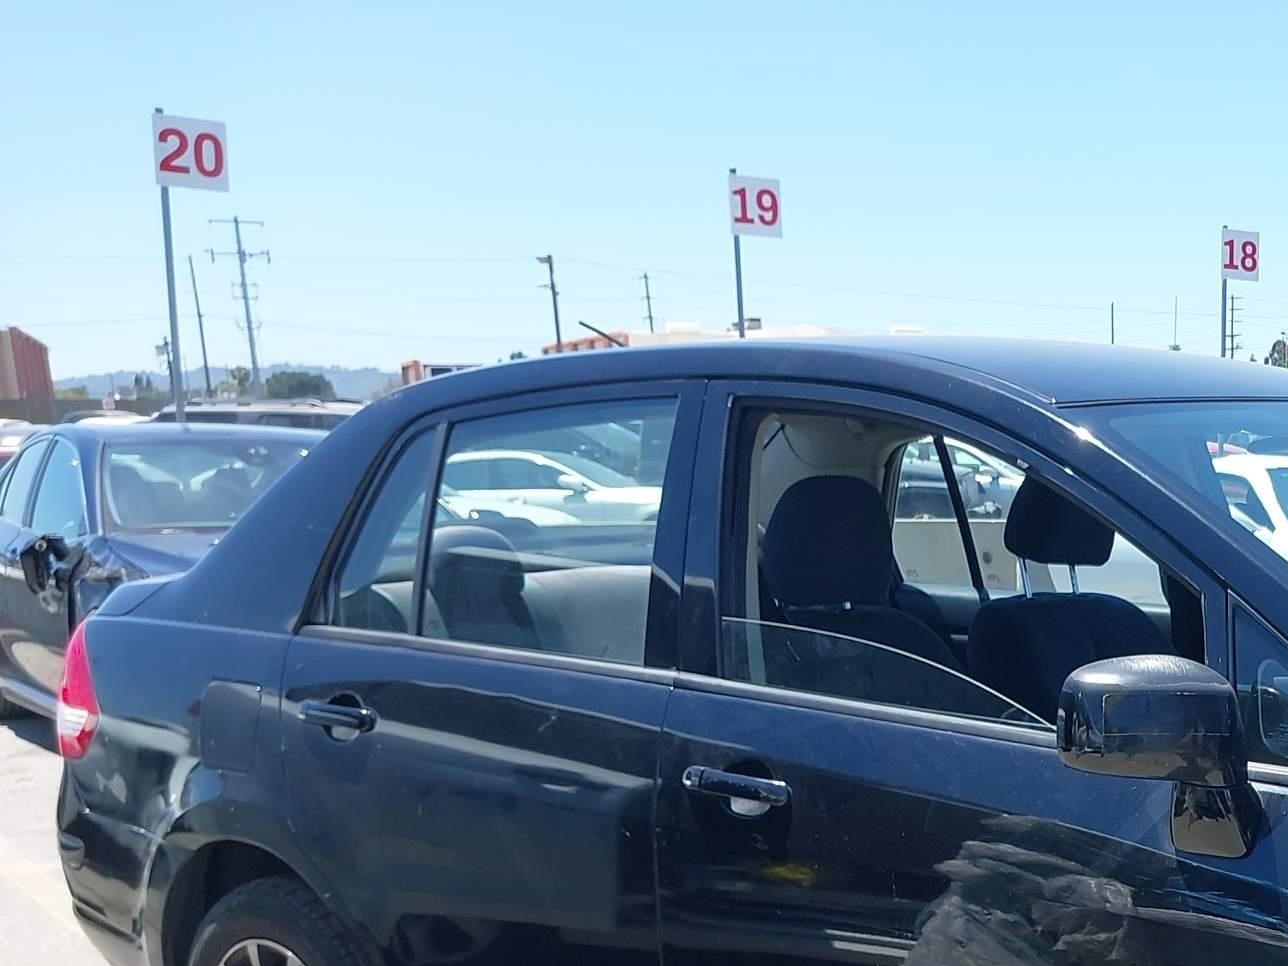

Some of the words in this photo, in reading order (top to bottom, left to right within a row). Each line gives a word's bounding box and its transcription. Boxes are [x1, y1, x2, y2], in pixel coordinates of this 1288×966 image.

[158, 128, 224, 178] 20
[733, 188, 780, 226] 19
[1223, 239, 1258, 273] 18
